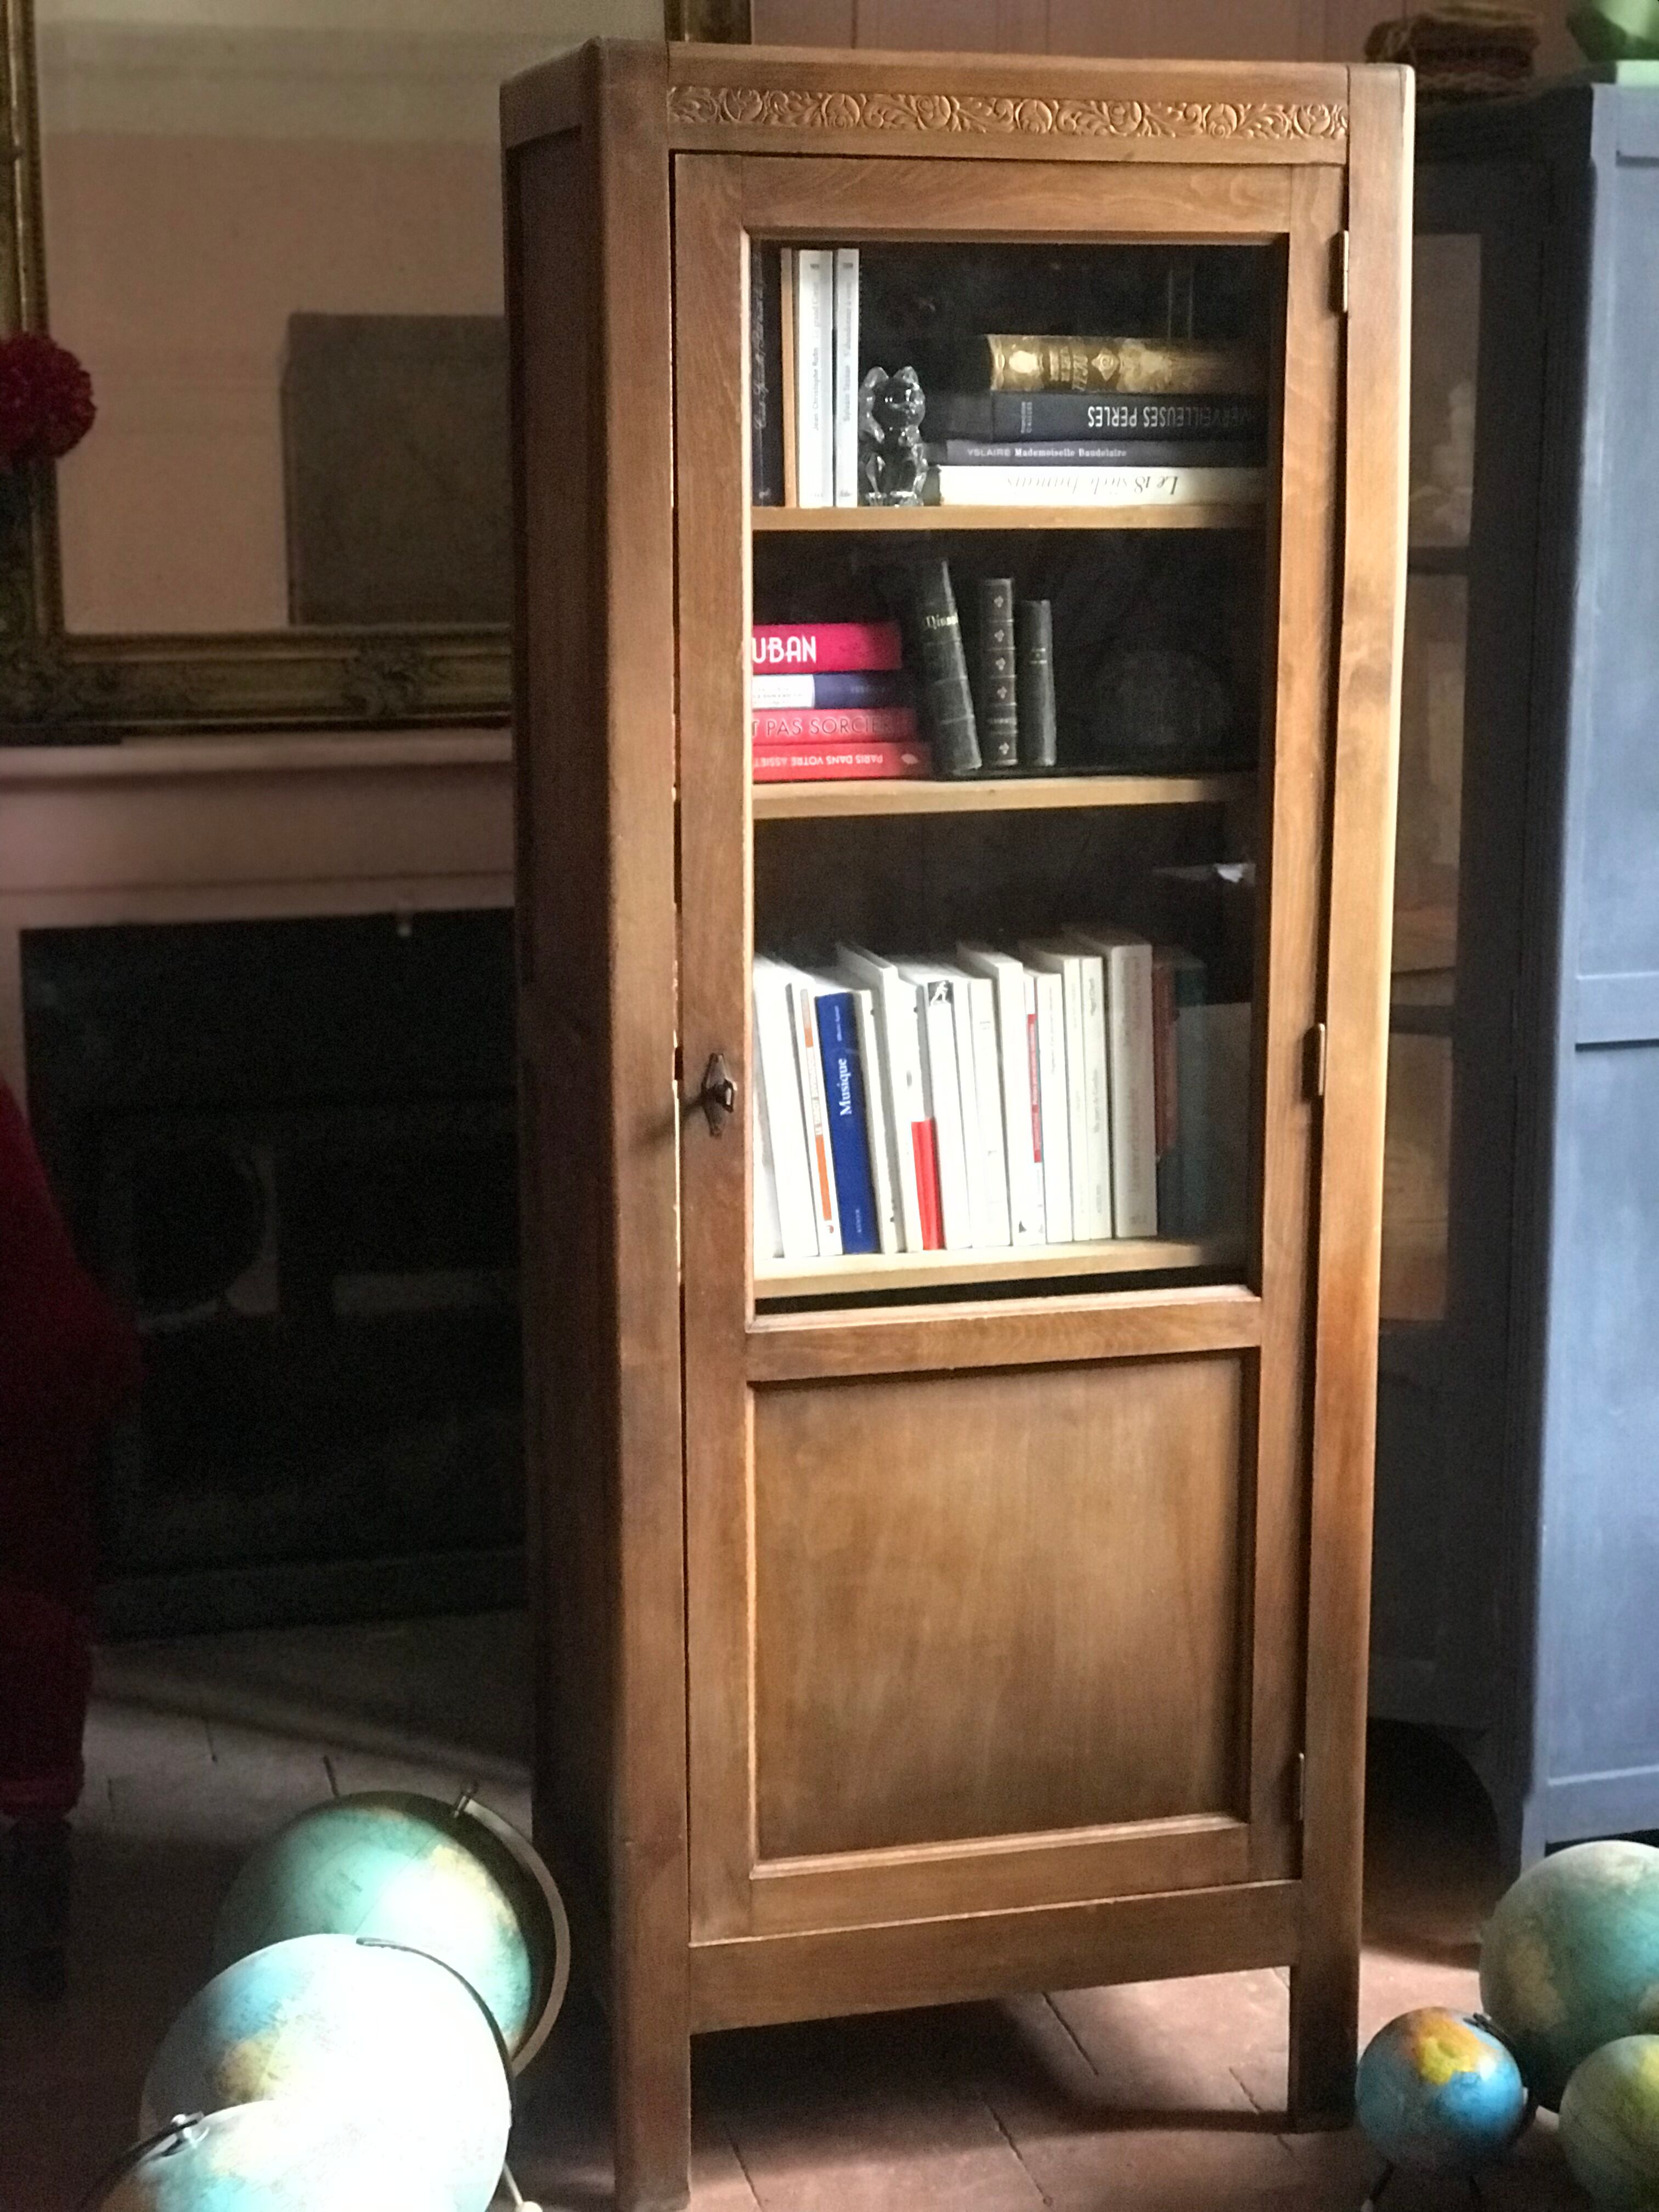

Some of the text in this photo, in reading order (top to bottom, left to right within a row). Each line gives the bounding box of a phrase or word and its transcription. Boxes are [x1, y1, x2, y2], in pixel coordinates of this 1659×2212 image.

[1087, 405, 1137, 428] PERLES
[967, 448, 1127, 458] YSLAIRE Mademoiselle Baudelaire
[1156, 476, 1179, 496] Le
[766, 718, 803, 736] PAS
[809, 715, 894, 735] SORCIER
[791, 755, 823, 766] VOTRE
[825, 754, 854, 765] DANS
[854, 754, 884, 764] PARIS
[837, 1058, 852, 1115] Musique
